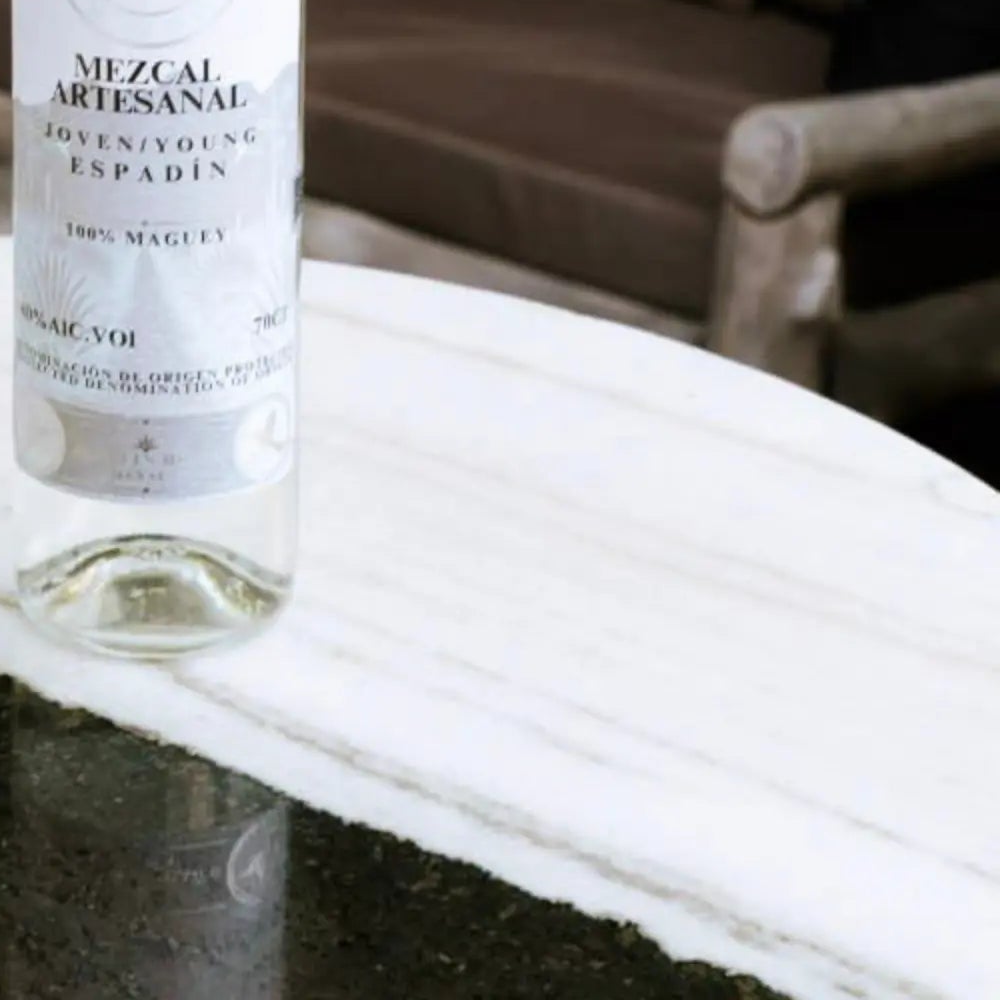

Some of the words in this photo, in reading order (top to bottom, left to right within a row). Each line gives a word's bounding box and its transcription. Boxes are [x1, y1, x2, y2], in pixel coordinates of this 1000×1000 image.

[74, 53, 221, 85] MEZCAL
[51, 80, 247, 115] ARTESANAL
[44, 121, 257, 153] JOVEN/YOUNG
[71, 156, 226, 183] ESPADÍN
[66, 221, 115, 244] 100%
[125, 226, 227, 248] MAGUEY
